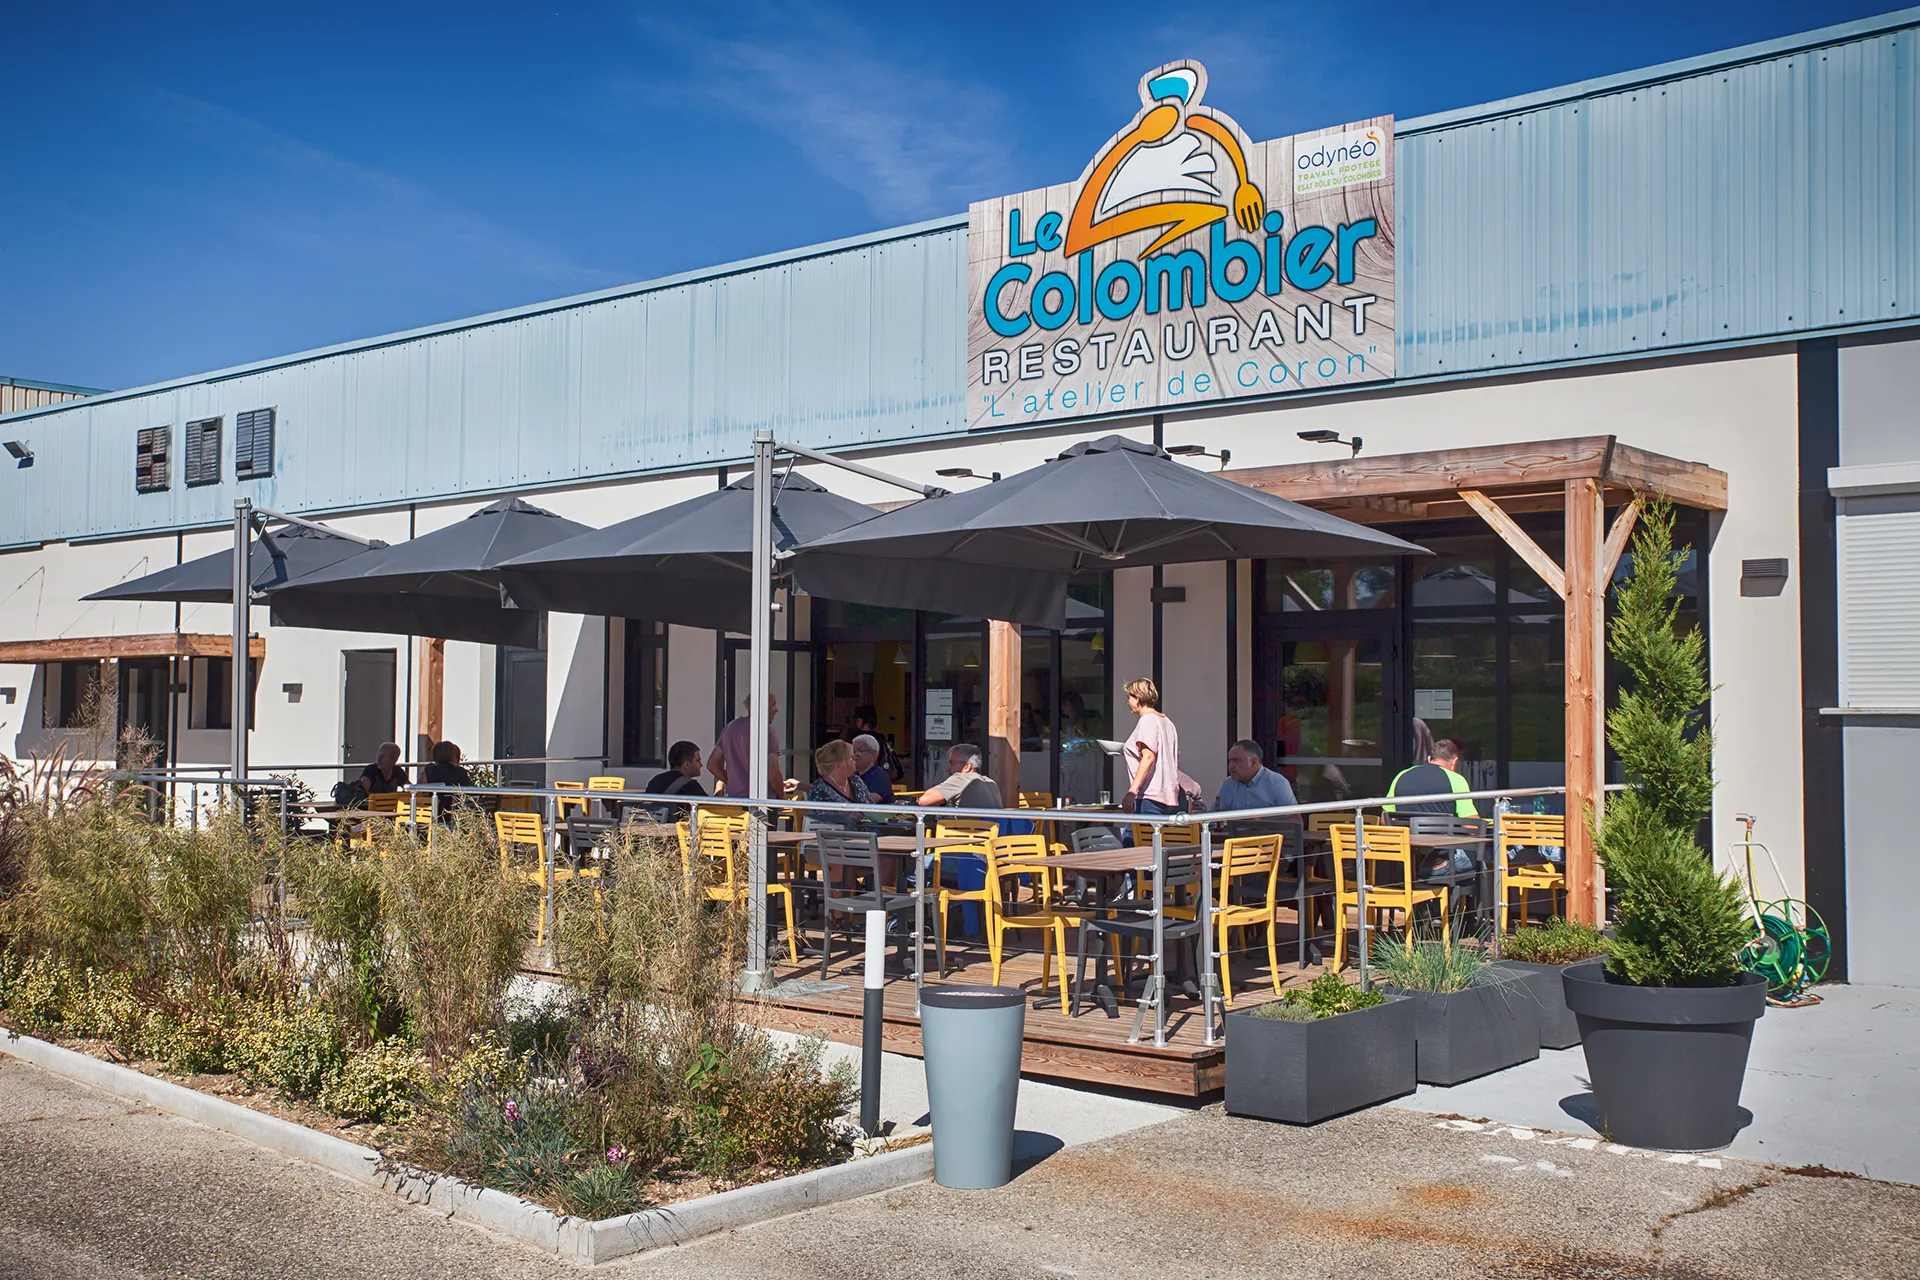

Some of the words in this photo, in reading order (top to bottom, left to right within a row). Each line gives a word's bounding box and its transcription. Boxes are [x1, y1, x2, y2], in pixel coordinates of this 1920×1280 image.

[1297, 140, 1377, 170] odynéo
[1297, 182, 1313, 192] ESAT
[1333, 176, 1342, 186] DU
[1344, 169, 1382, 183] COLOMBIER
[1298, 169, 1336, 182] TRAVAIL
[1009, 209, 1063, 257] Le
[983, 211, 1377, 337] Colombier
[982, 295, 1377, 385] RESTAURANT
[1167, 370, 1211, 397] de
